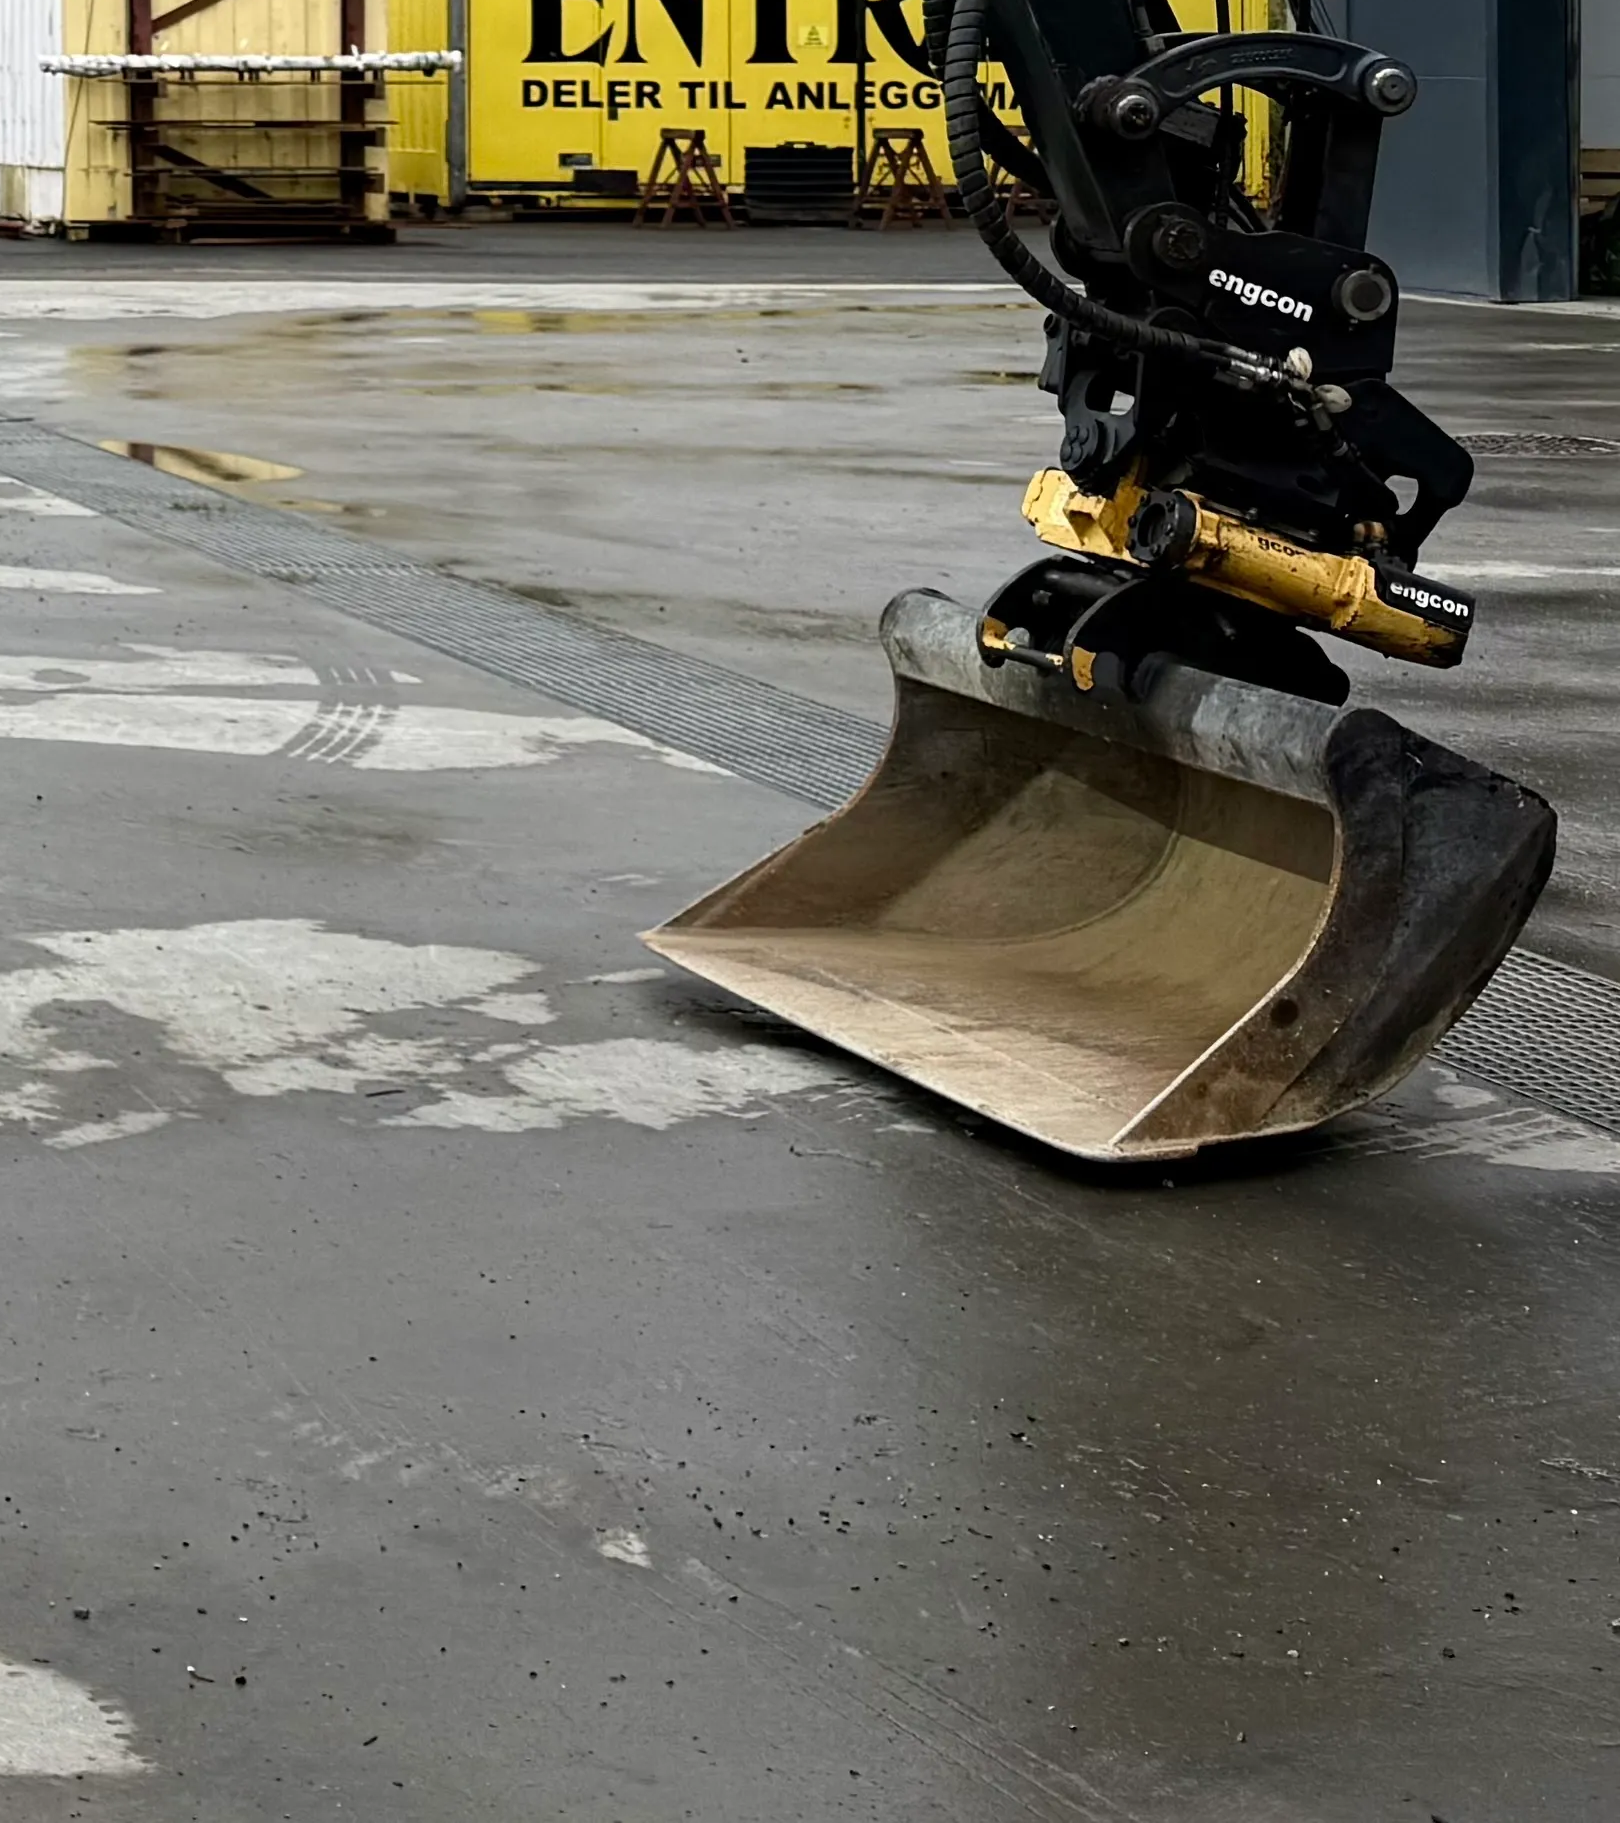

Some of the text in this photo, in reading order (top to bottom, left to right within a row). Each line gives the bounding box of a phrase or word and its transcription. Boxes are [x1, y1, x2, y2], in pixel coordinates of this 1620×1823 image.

[522, 79, 662, 110] DELER
[679, 80, 747, 110] TIL
[1209, 269, 1313, 322] engcon
[1389, 581, 1469, 617] engcon
